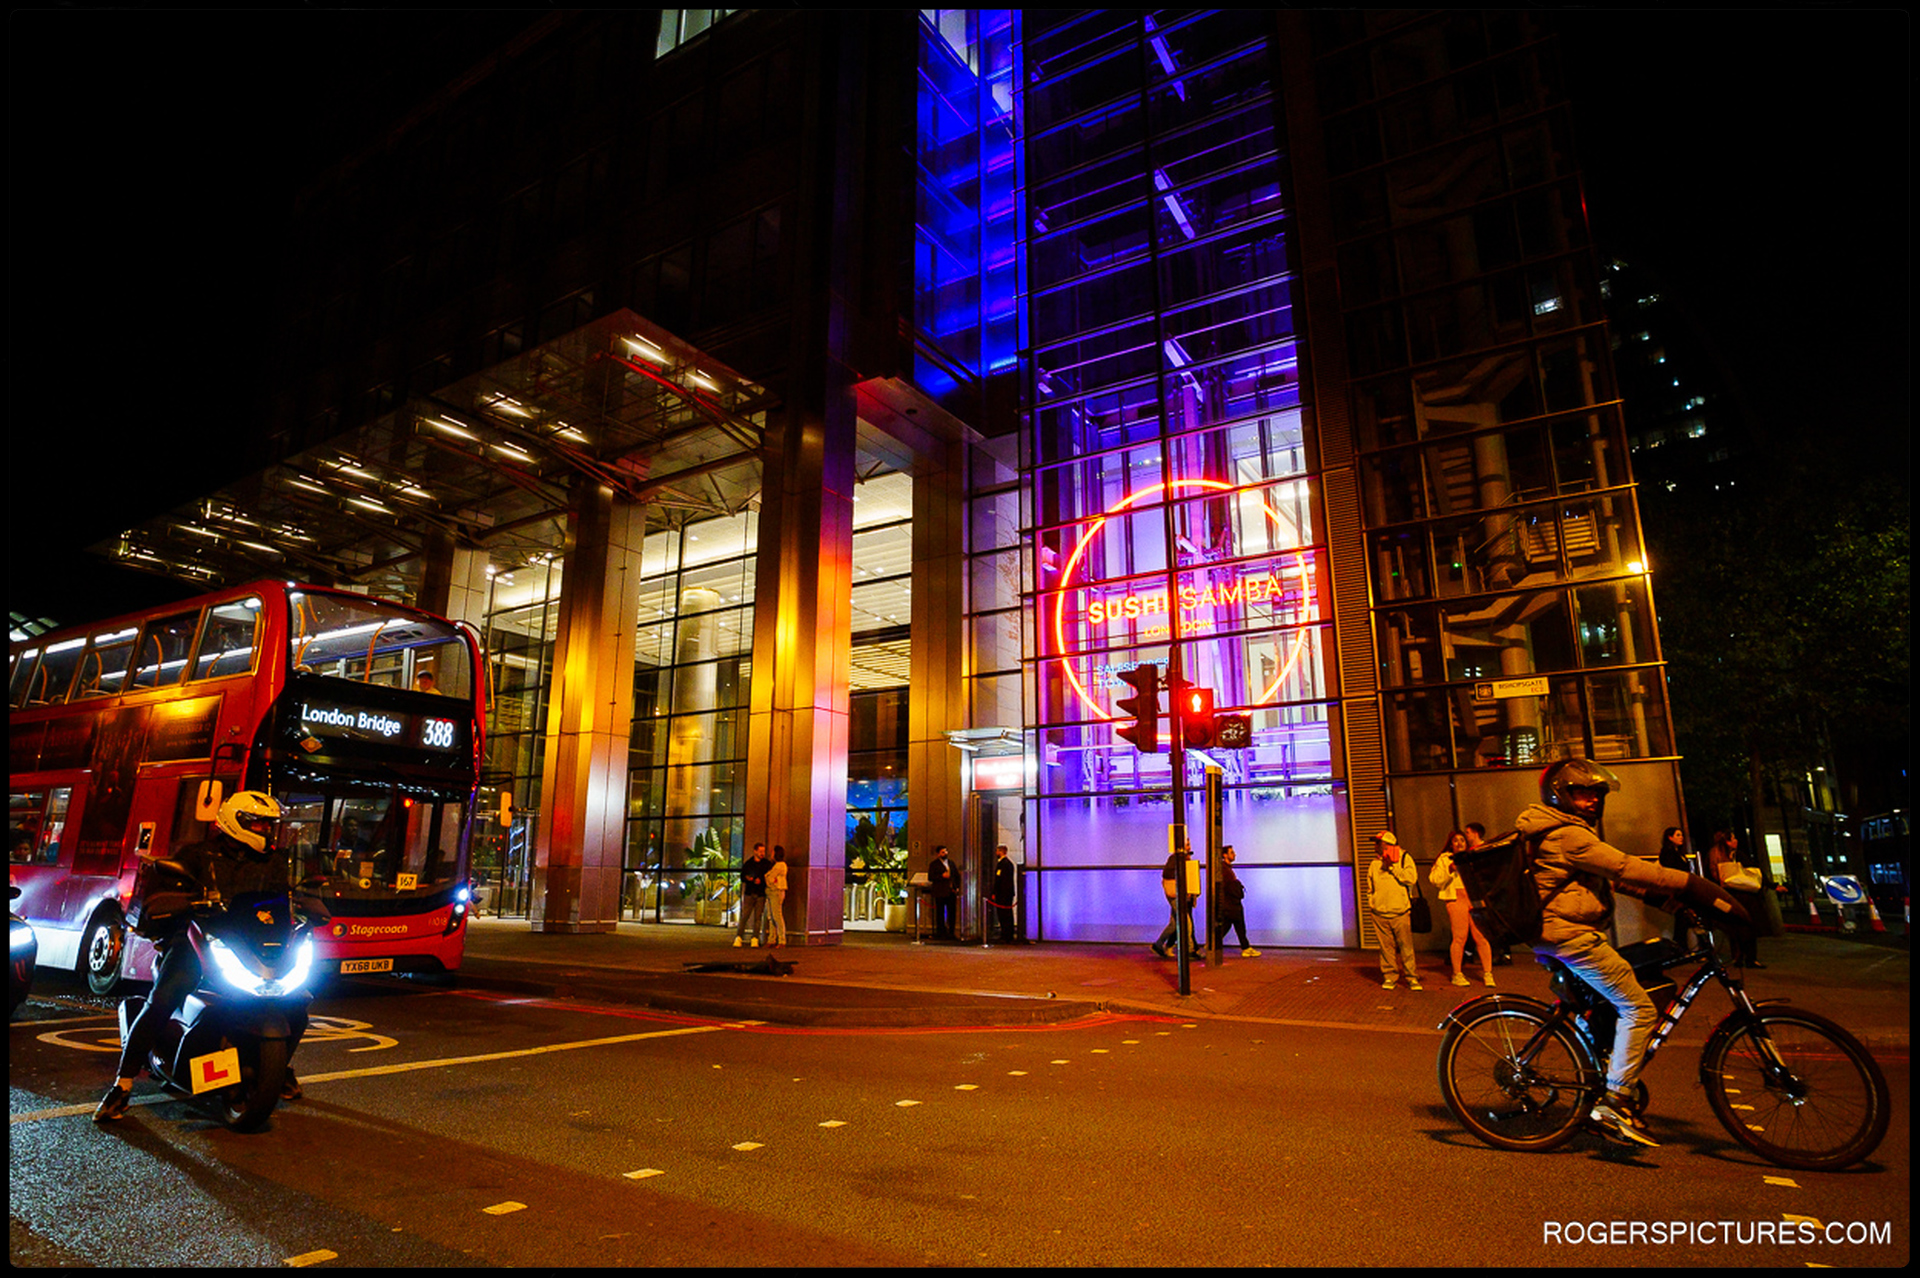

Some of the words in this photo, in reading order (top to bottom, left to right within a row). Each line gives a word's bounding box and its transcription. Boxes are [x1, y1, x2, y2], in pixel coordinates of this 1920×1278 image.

[1181, 575, 1283, 611] SAMBA
[301, 703, 355, 727] London
[357, 711, 401, 737] Bridge
[423, 719, 454, 748] 388
[350, 924, 409, 938] Stagecoach
[345, 961, 370, 972] YX68
[203, 1060, 229, 1083] L
